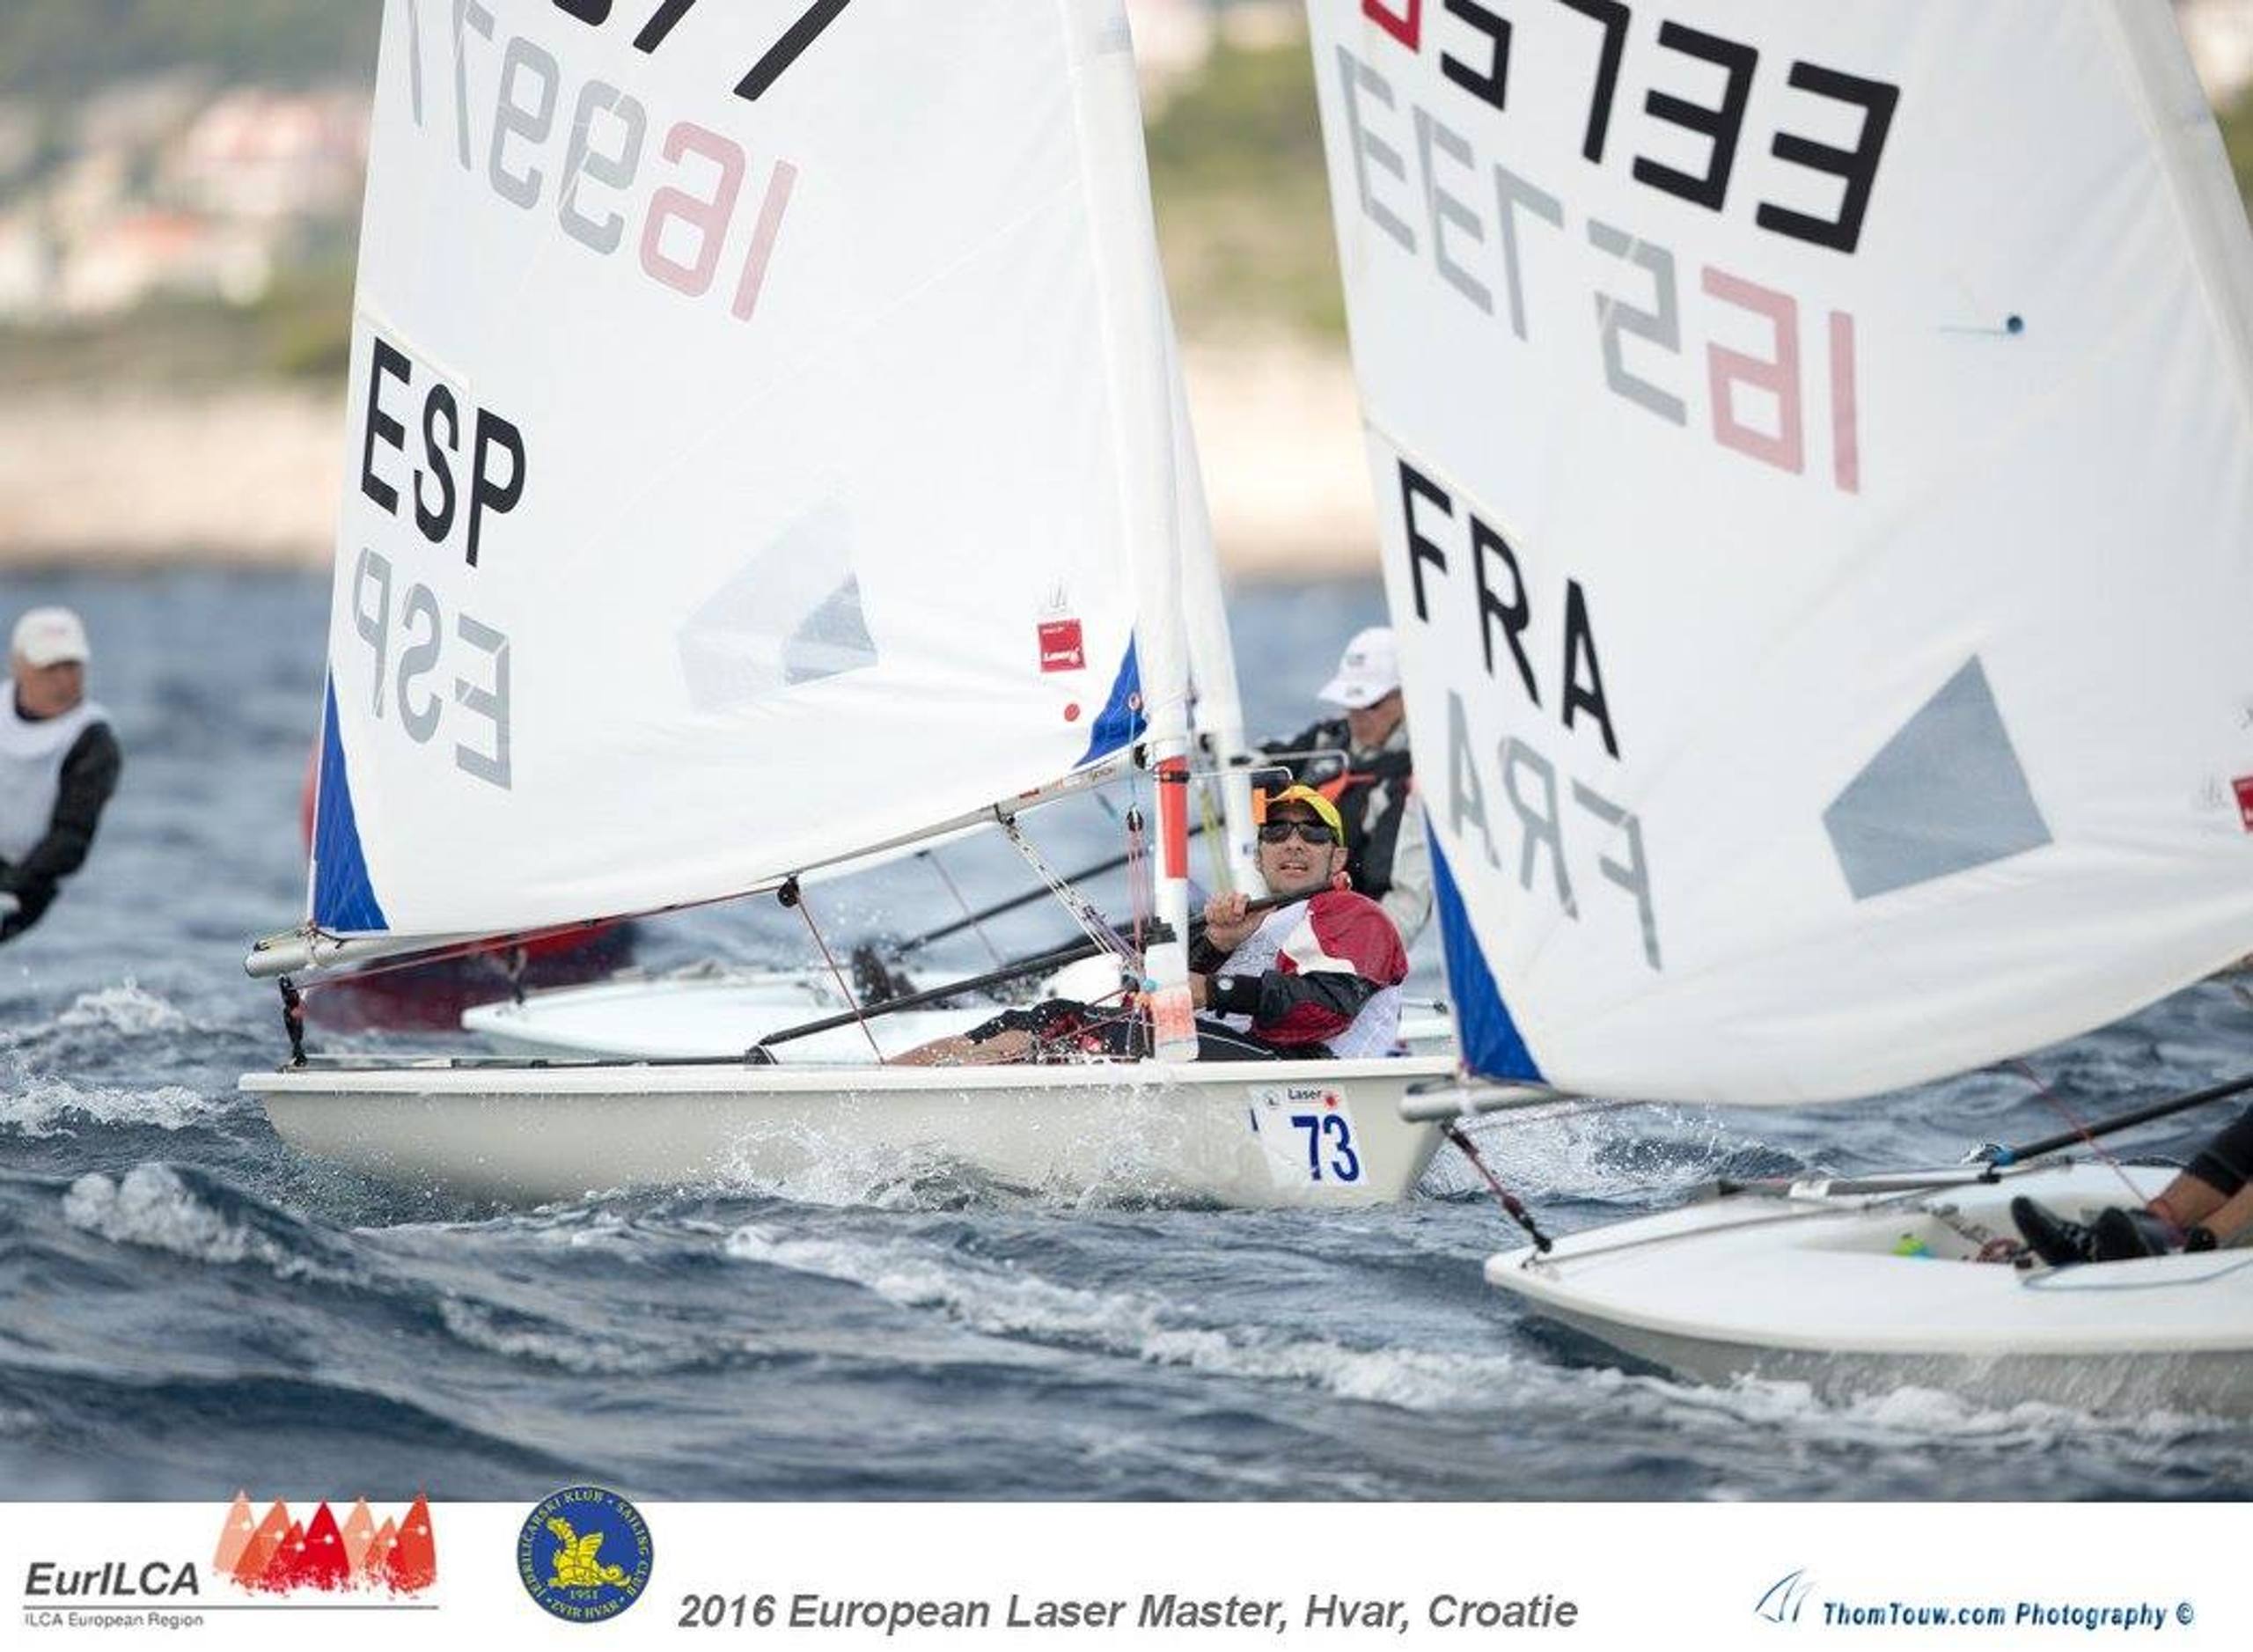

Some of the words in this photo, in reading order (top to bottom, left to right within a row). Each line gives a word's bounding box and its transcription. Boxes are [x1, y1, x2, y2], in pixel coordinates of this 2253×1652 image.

[1360, 0, 1901, 255] 5733
[361, 336, 526, 568] ESP
[1398, 458, 1620, 761] FRA
[1287, 1087, 1322, 1100] Laser
[1291, 1114, 1360, 1181] 73
